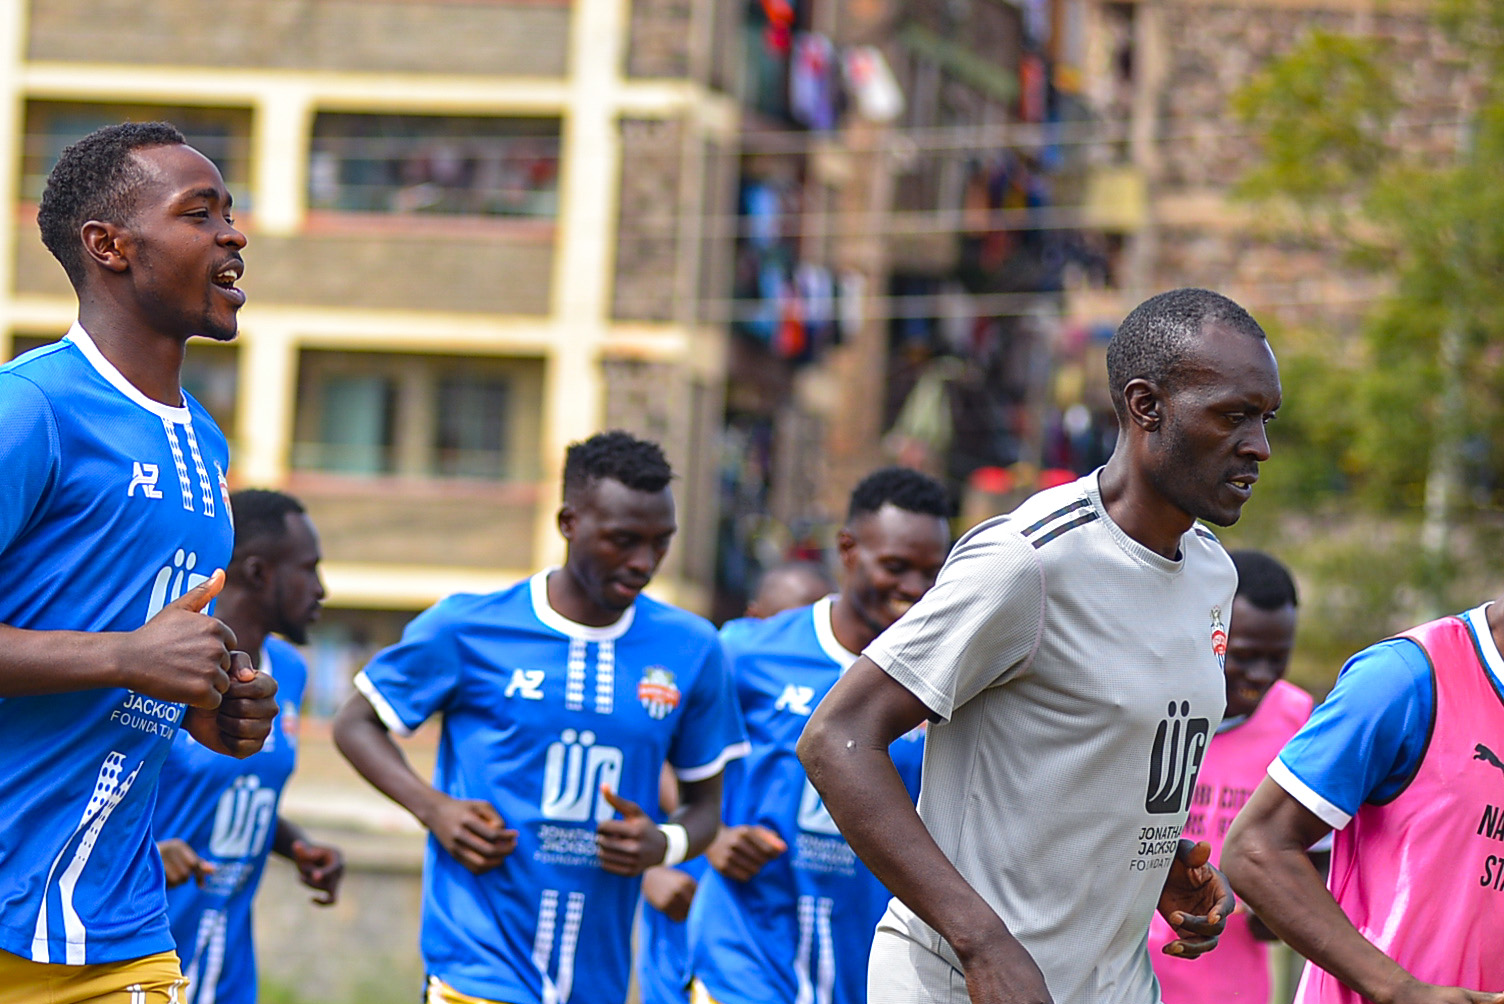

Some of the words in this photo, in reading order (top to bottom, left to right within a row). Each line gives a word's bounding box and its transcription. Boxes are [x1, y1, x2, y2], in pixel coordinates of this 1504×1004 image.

[128, 461, 163, 499] AZ
[504, 668, 545, 700] AZ
[1138, 826, 1182, 841] JONATHA
[1138, 840, 1177, 855] JACKSO
